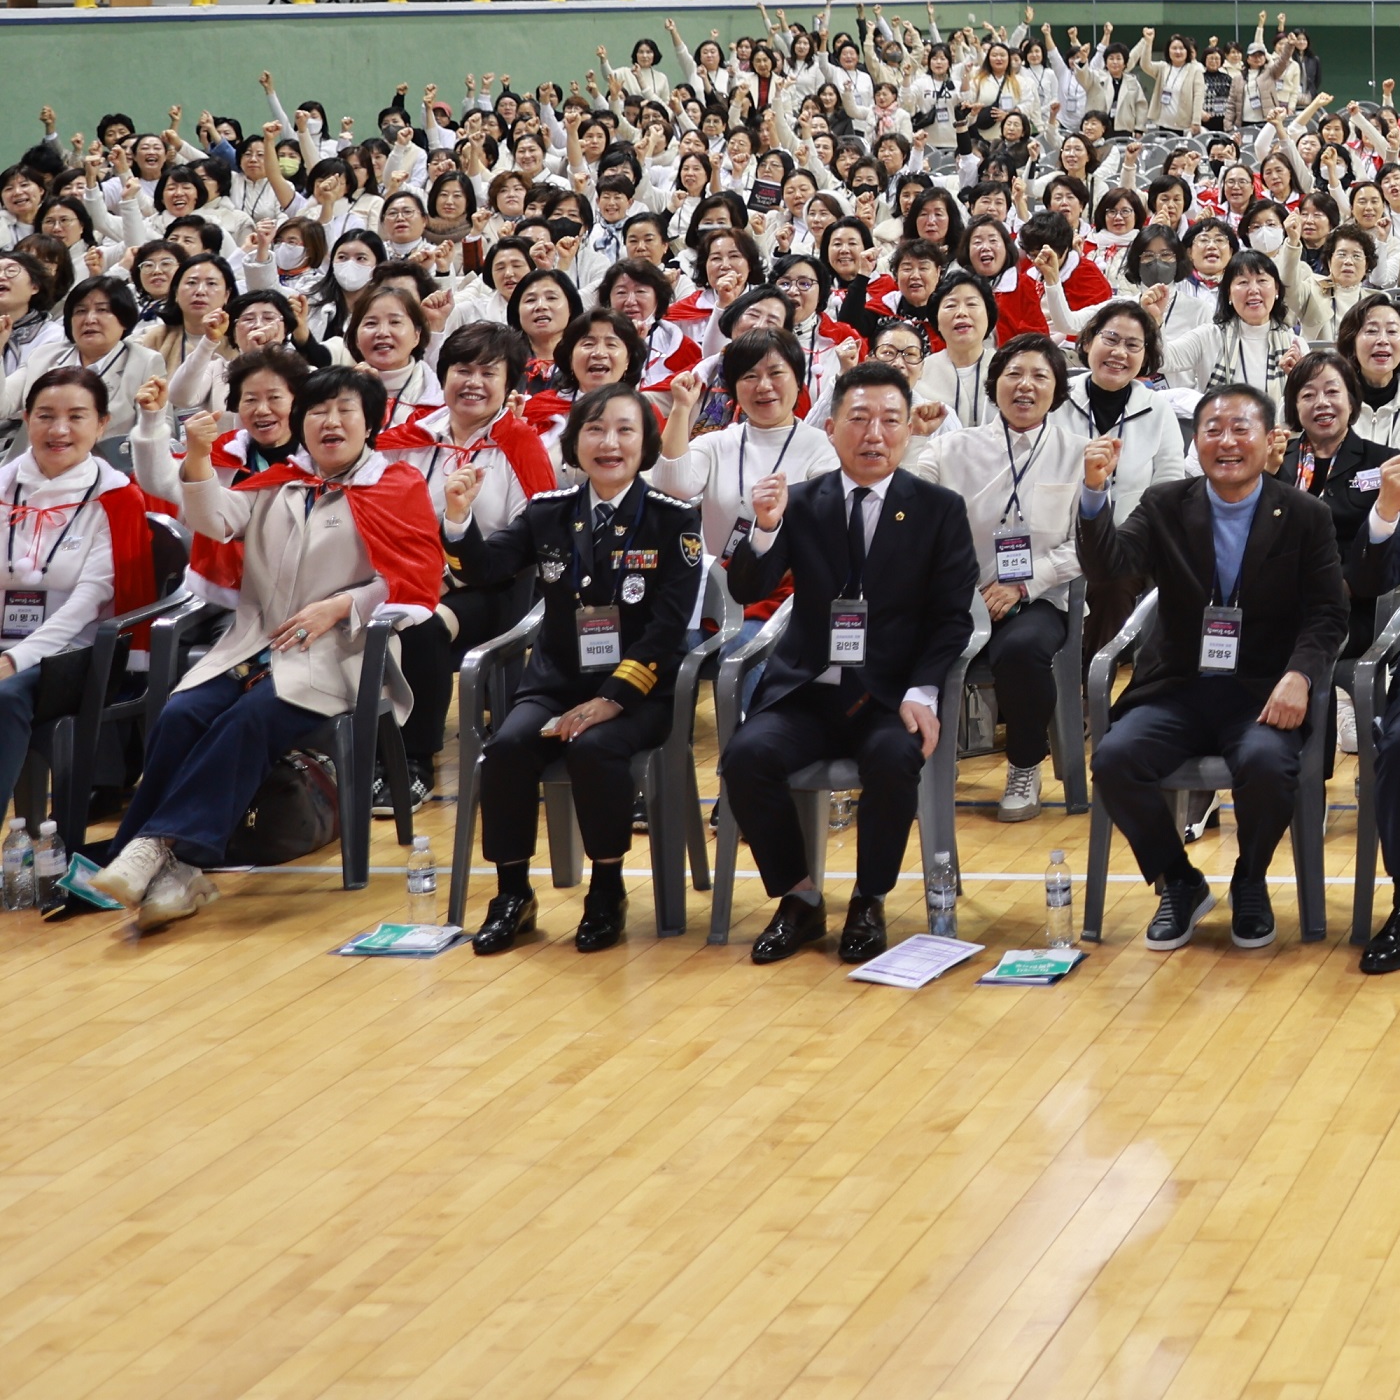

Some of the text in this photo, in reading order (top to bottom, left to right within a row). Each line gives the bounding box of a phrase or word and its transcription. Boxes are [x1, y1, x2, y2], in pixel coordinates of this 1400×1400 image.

[1002, 558, 1028, 568] 정선숙
[9, 613, 39, 623] 이명자
[587, 644, 614, 655] 박미영
[836, 641, 860, 650] 김인정
[1207, 648, 1232, 658] 장영우
